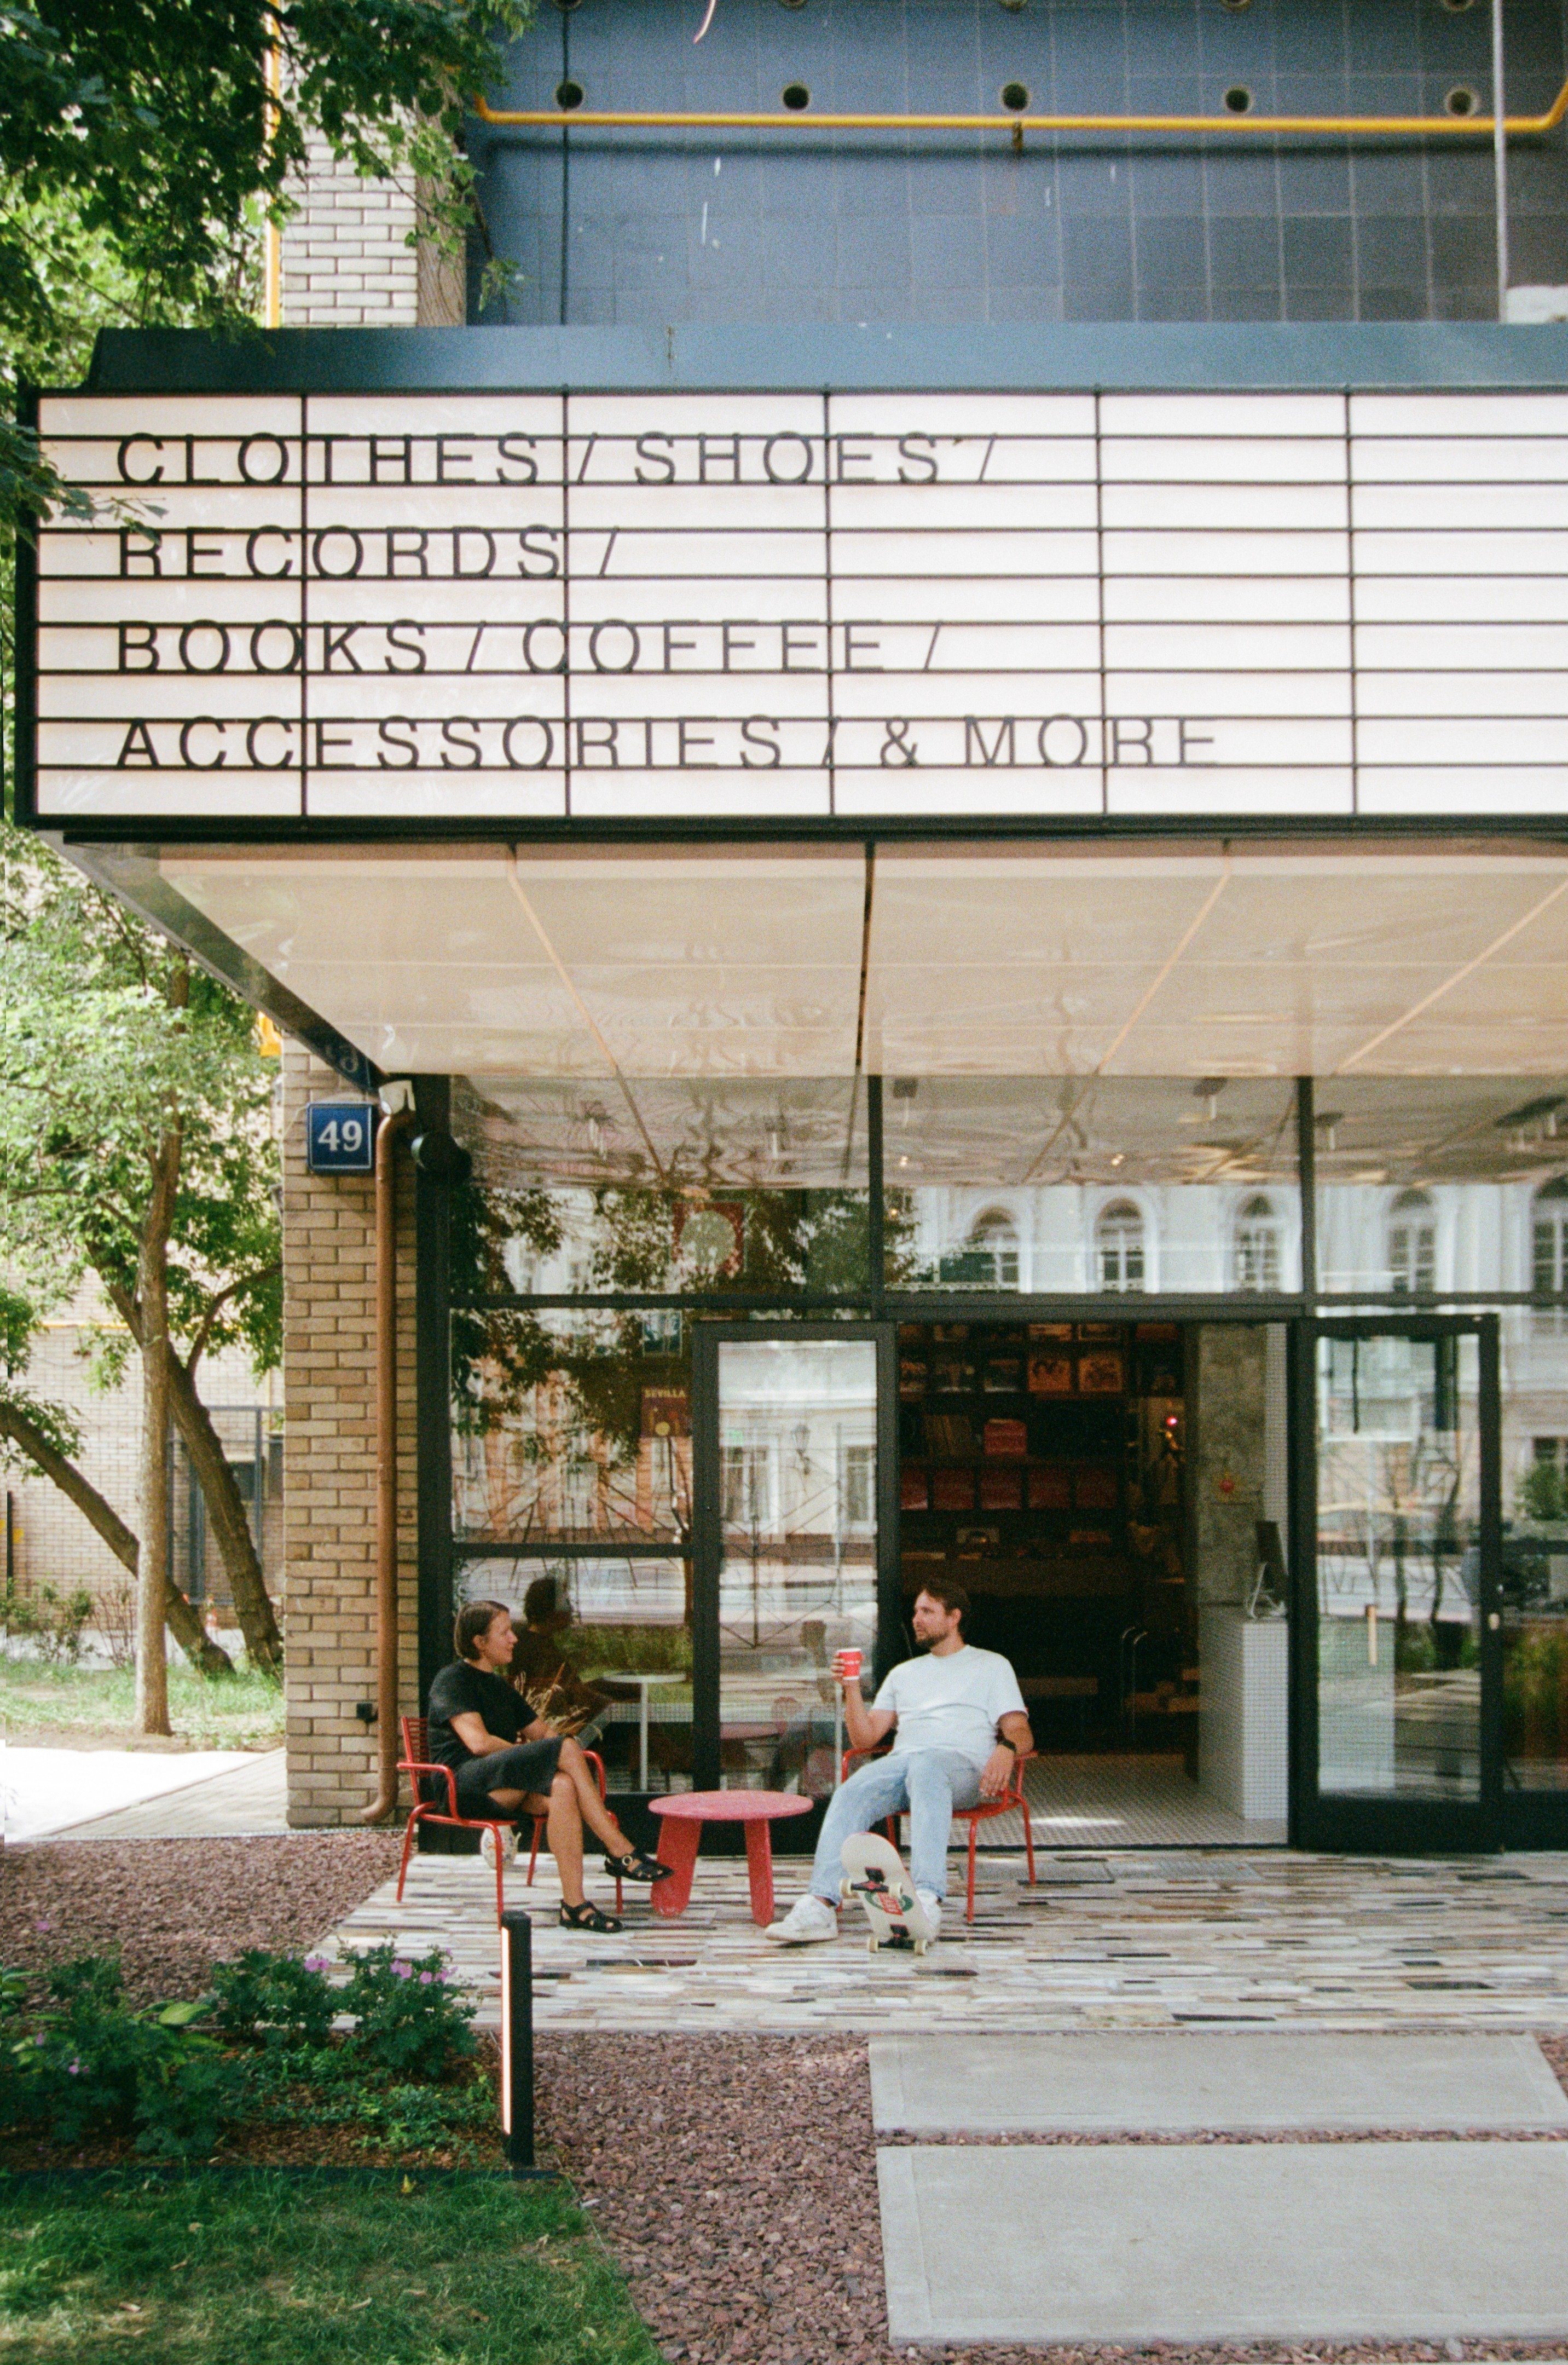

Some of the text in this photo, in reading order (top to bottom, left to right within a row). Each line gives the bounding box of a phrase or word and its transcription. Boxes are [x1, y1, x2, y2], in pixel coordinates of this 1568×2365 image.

[117, 432, 539, 484] CLOTHES
[634, 431, 938, 484] SHOES
[118, 524, 560, 578] RECORDS
[118, 619, 427, 673] BOOKS
[522, 619, 884, 673] COFFEE
[117, 715, 782, 768] ACCESSORIES
[879, 716, 919, 768] &
[963, 714, 1218, 768] MORE
[317, 1120, 362, 1152] 49
